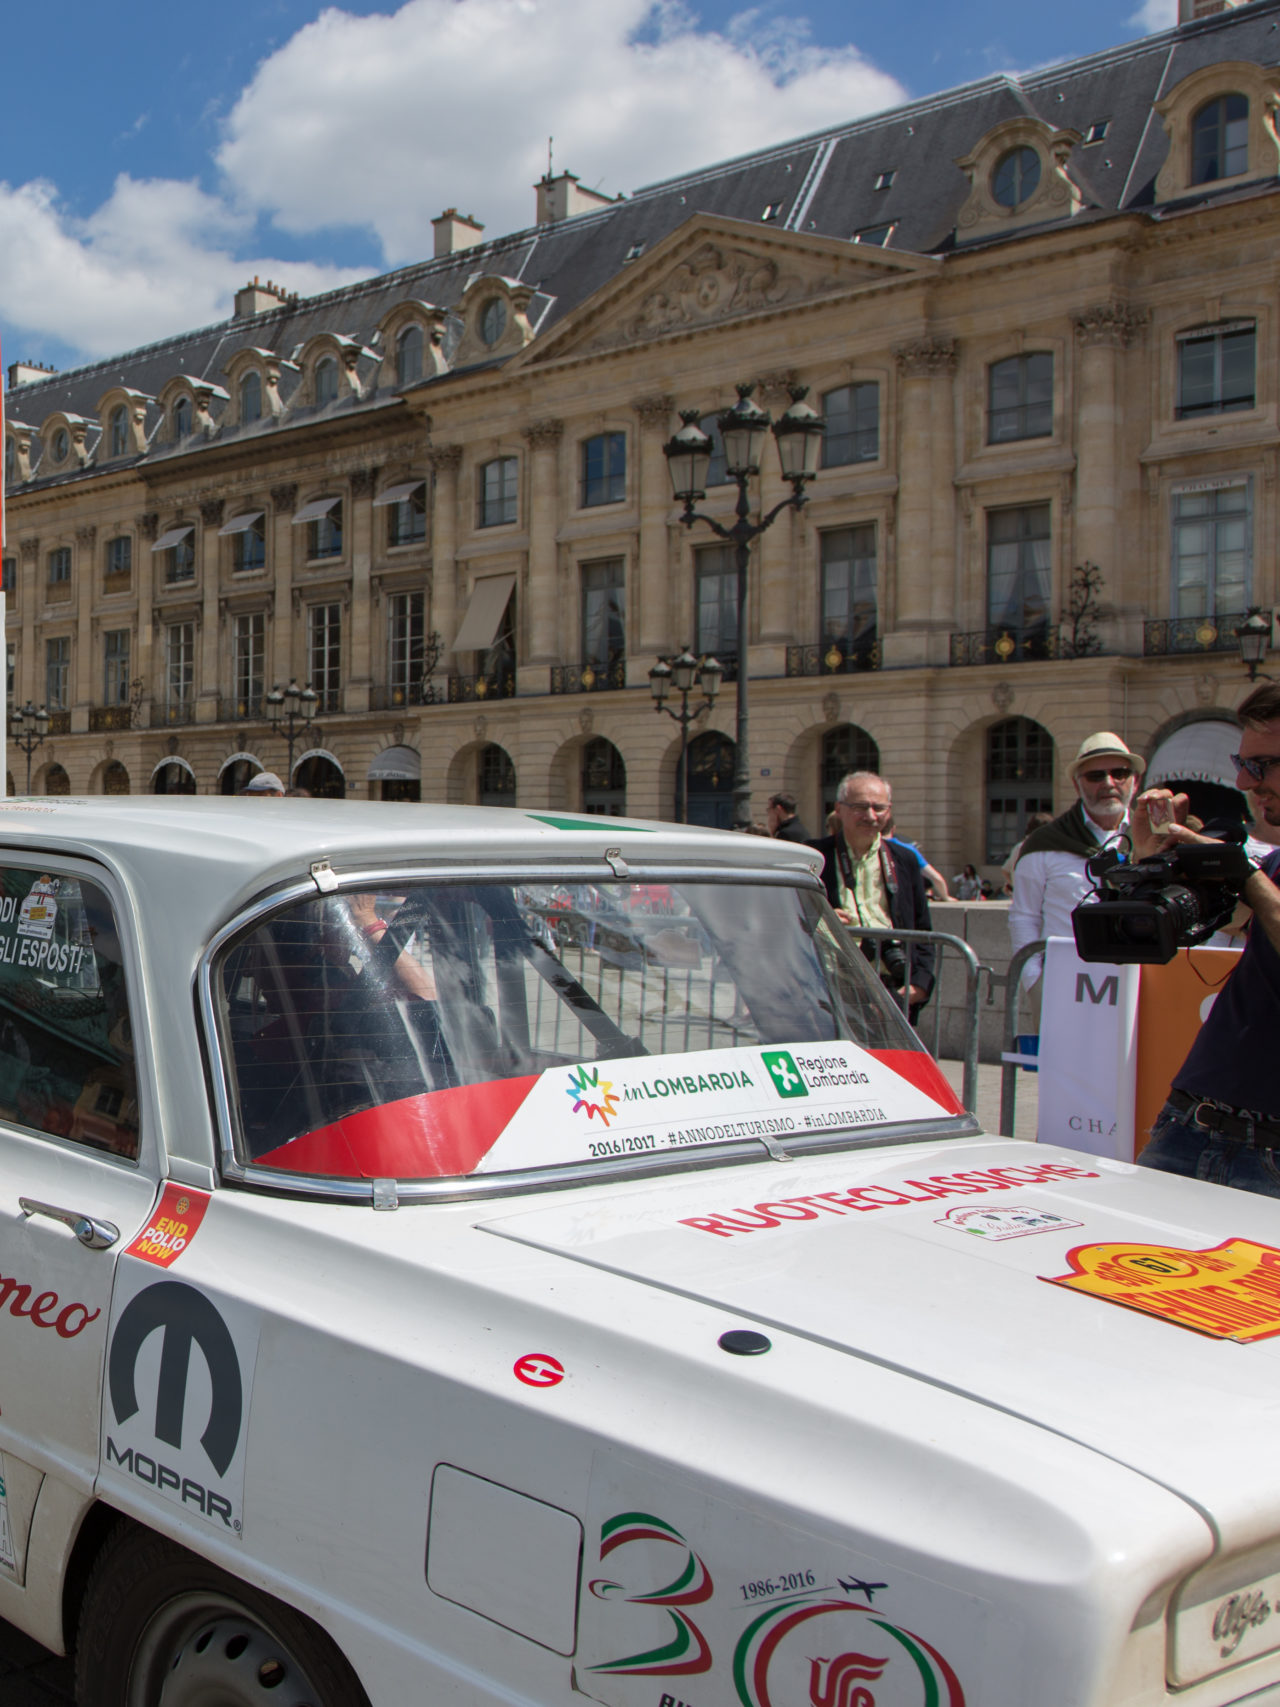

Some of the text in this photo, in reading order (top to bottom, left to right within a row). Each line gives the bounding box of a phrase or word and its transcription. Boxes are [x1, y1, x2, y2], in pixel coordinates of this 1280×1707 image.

[18, 938, 84, 975] ESPOSTI
[1075, 972, 1119, 1007] M
[796, 1054, 849, 1072] Regione
[803, 1069, 870, 1089] Lombardia
[588, 1106, 888, 1158] 2016/2017 #ANNODELTURISMO #inLOMBARDIA
[676, 1163, 1102, 1238] RUOTECLASSICHE
[141, 1227, 186, 1252] POLIO
[155, 1216, 189, 1238] END
[136, 1239, 176, 1260] NOW
[1129, 1257, 1181, 1274] 67
[106, 1435, 233, 1529] MOPAR
[739, 1569, 817, 1601] 1986-2016
